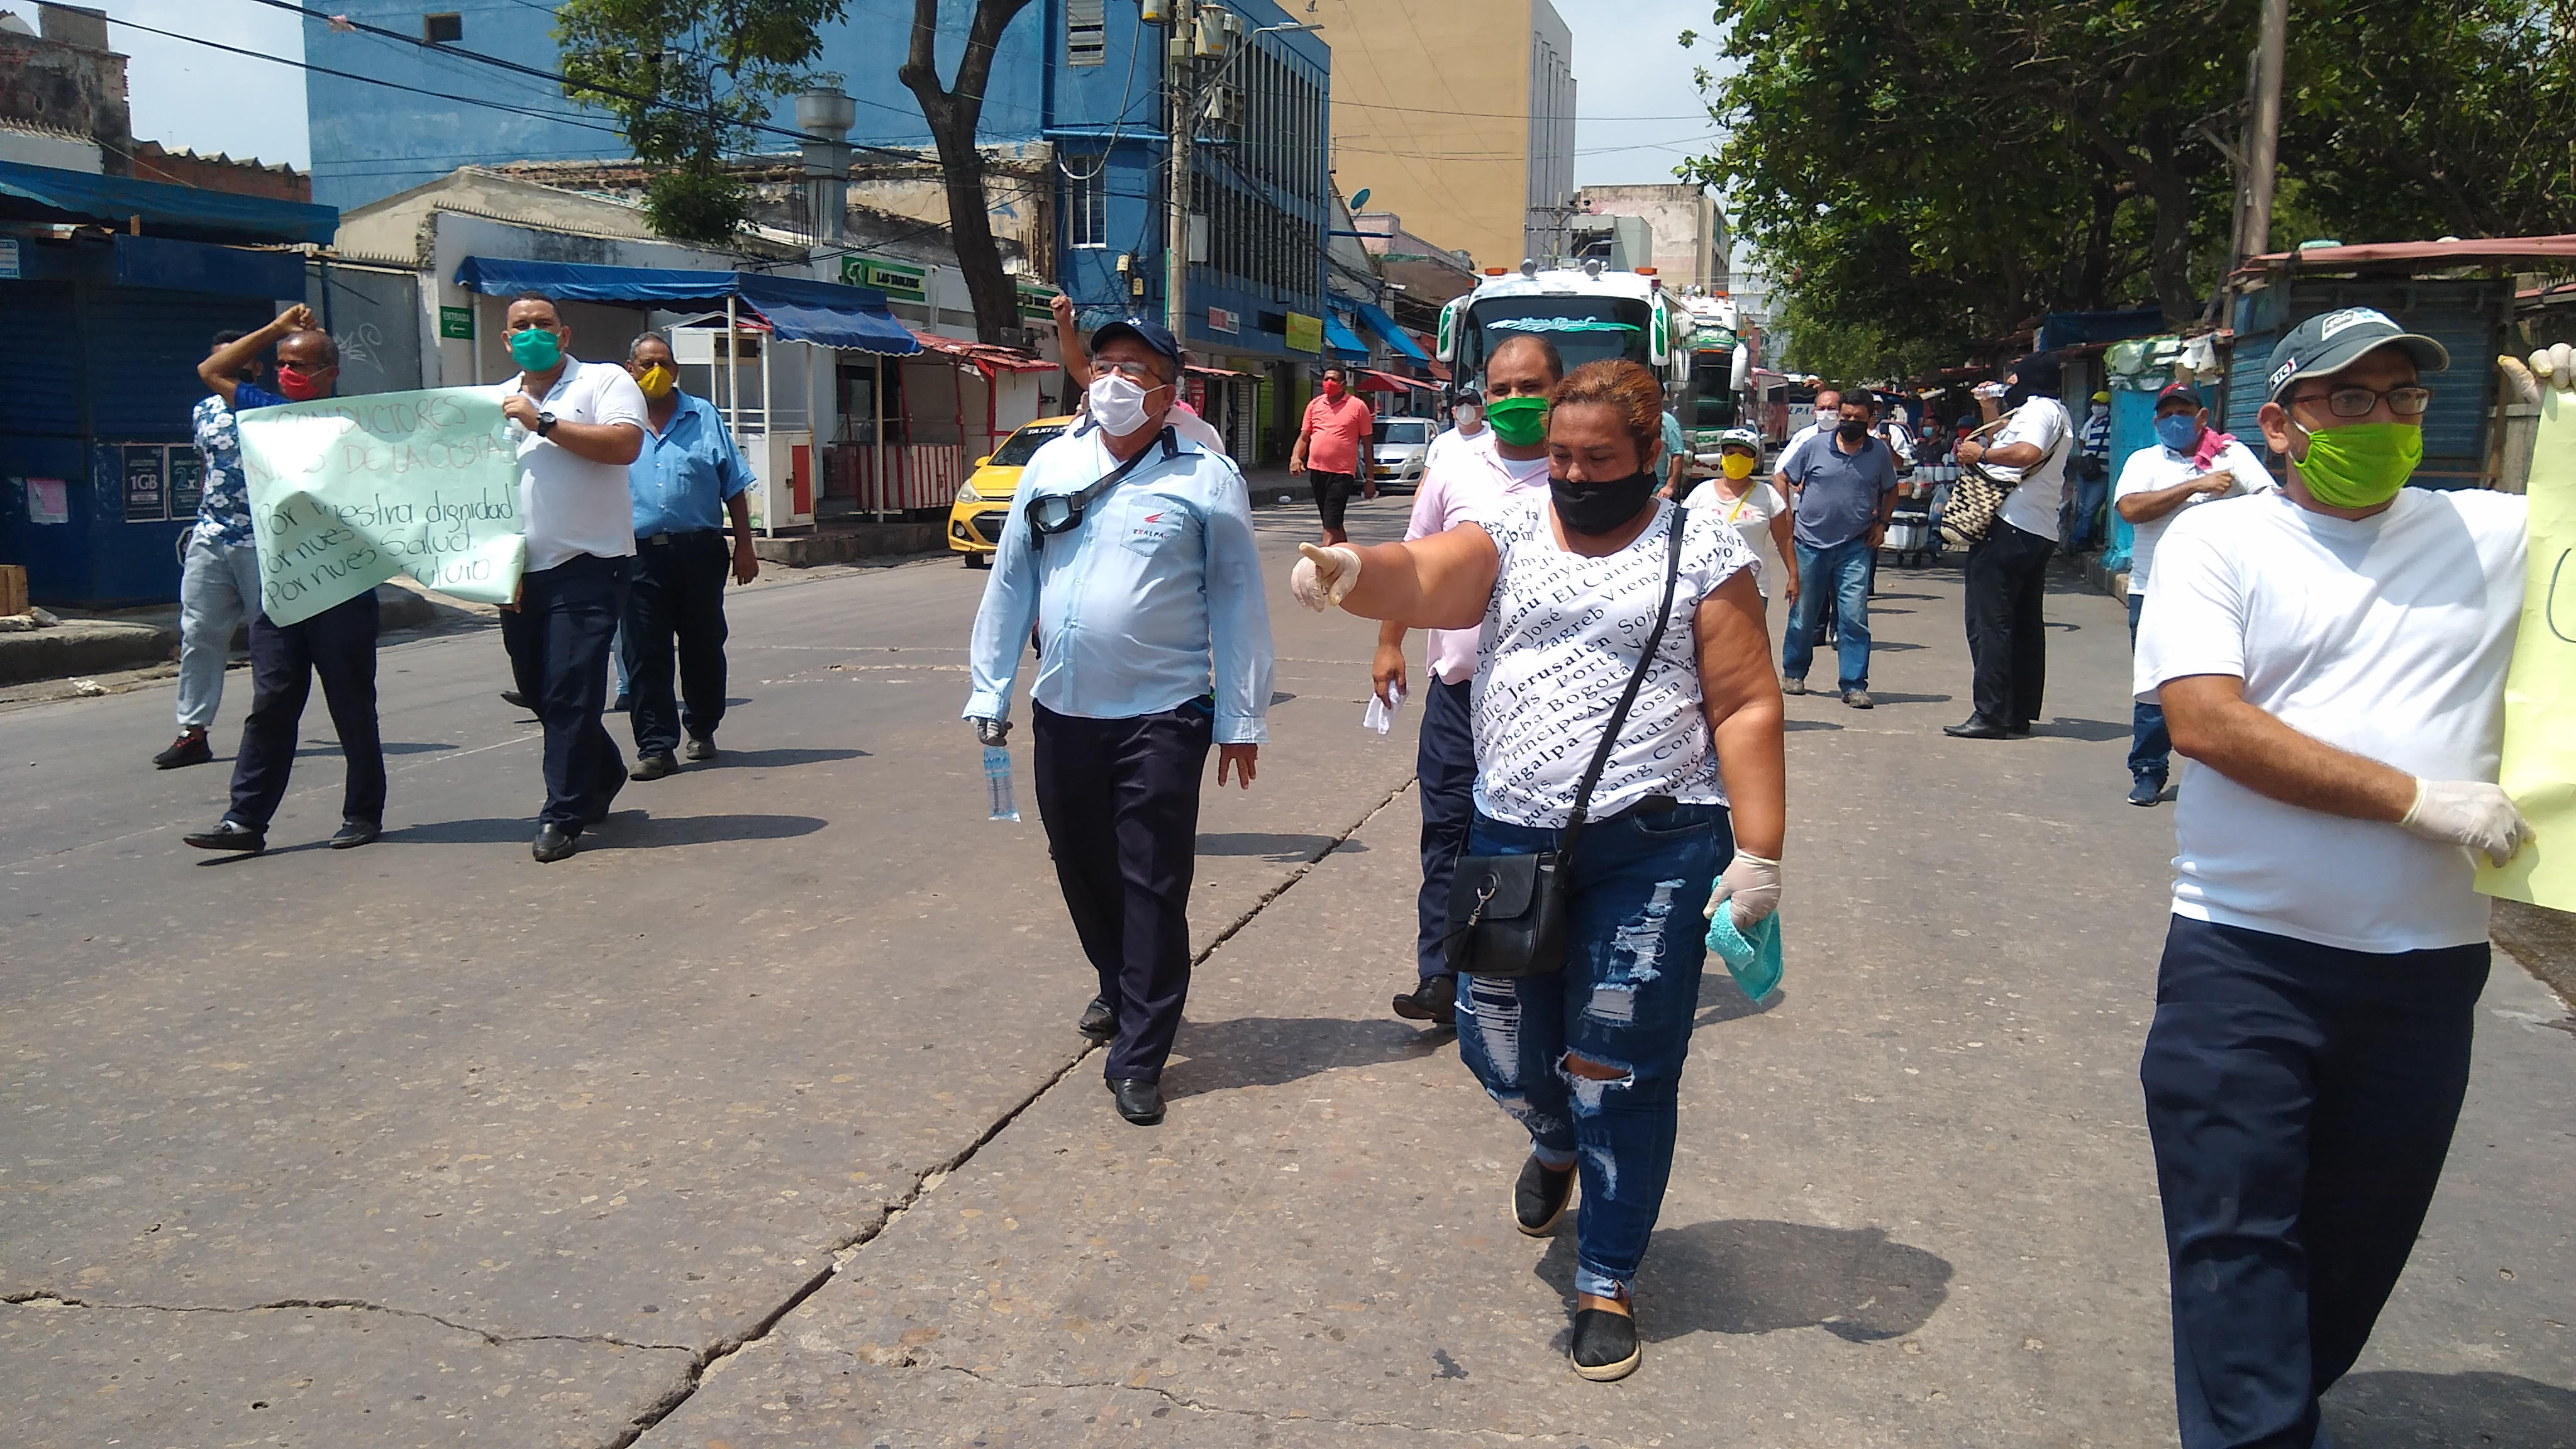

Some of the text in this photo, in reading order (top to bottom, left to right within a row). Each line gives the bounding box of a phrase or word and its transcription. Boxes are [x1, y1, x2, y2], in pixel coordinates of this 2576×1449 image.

[130, 474, 158, 490] 1GB
[258, 502, 298, 540] Por
[425, 483, 513, 532] dignidad
[296, 527, 355, 560] nues
[265, 580, 308, 609] Por
[313, 547, 377, 586] nues
[1552, 585, 1579, 604] El
[1582, 557, 1644, 587] Cairo
[1599, 572, 1661, 602] Viena
[1521, 608, 1562, 644] José
[1534, 608, 1604, 656] Zagreb
[1507, 636, 1613, 702] Jerusalén
[1545, 662, 1631, 713] Bogotá
[1556, 650, 1619, 689] Porto
